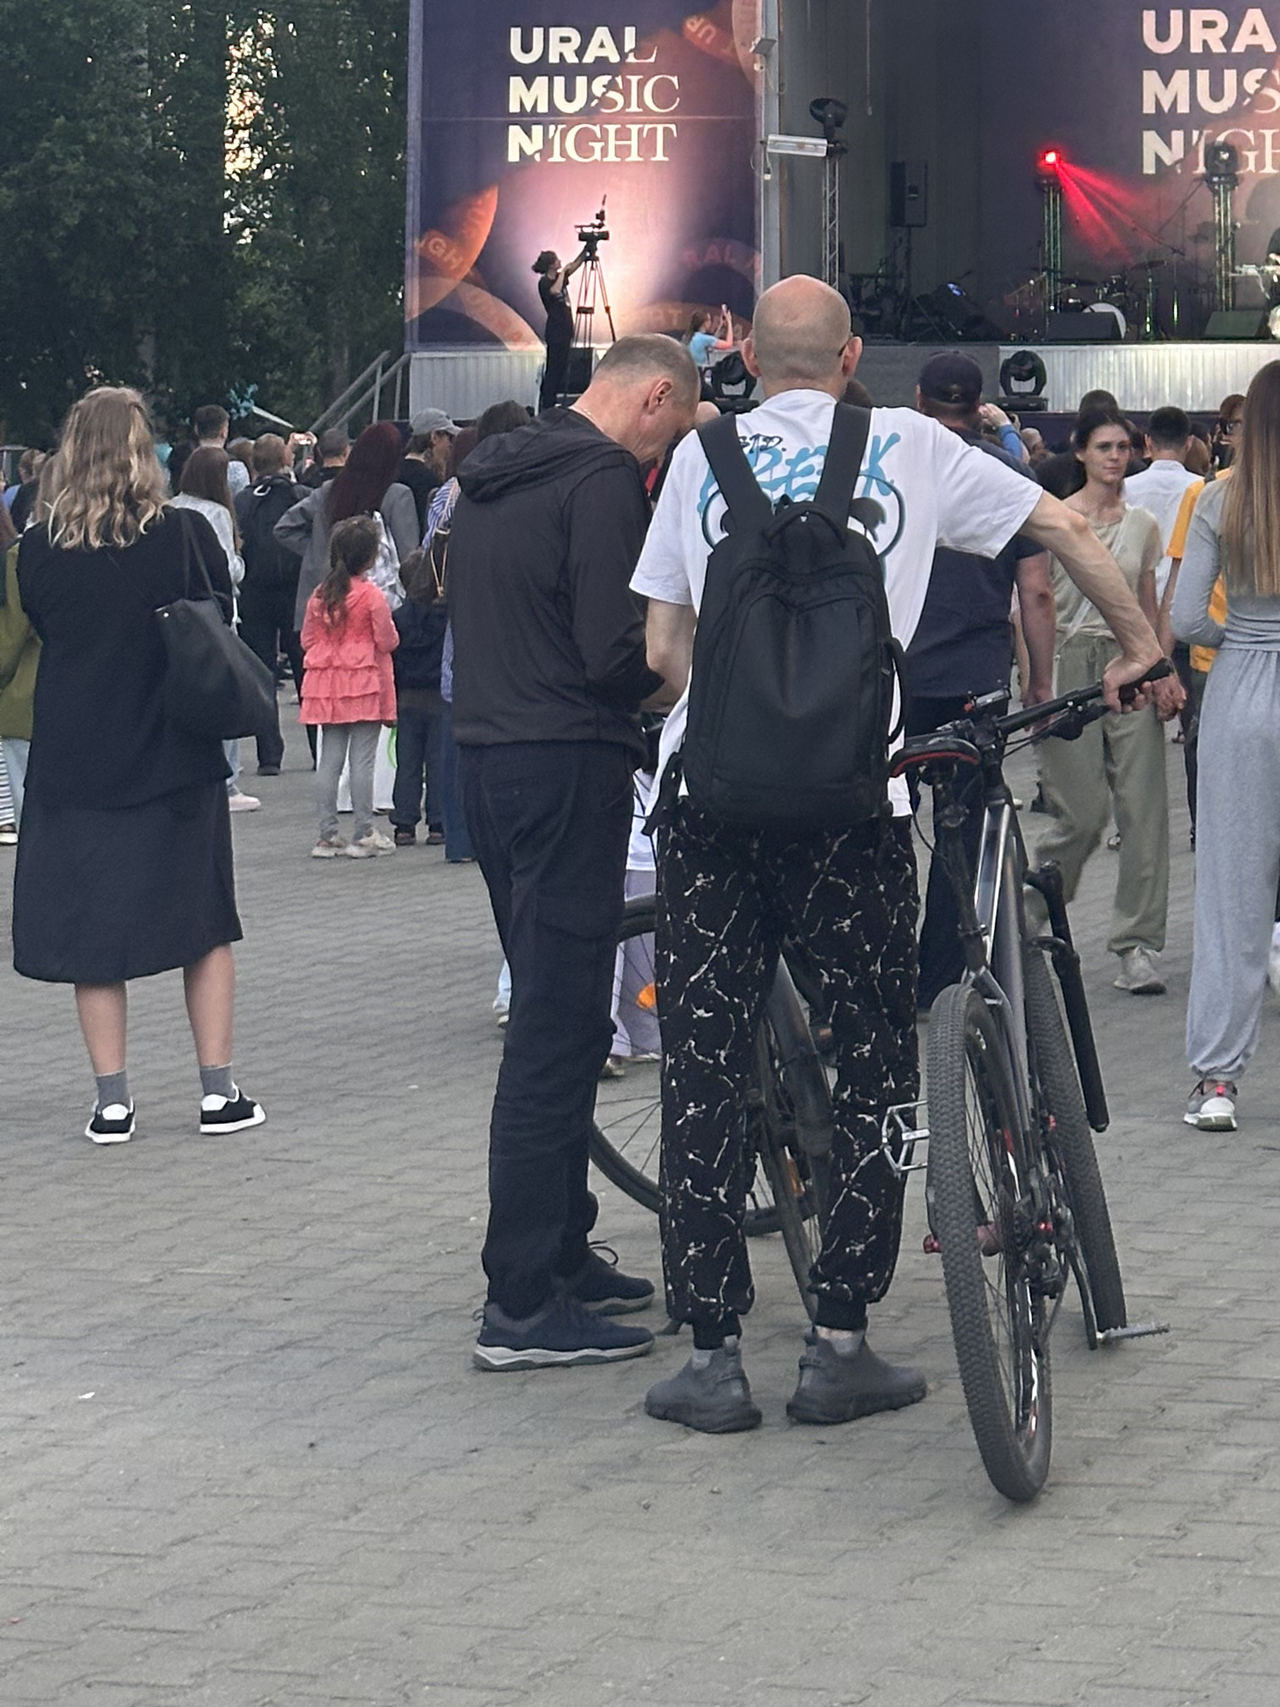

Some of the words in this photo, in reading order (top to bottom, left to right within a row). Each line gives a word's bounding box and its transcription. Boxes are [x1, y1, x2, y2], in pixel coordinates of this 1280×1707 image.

[510, 26, 658, 64] URAL
[509, 74, 680, 113] MUSIC
[508, 124, 678, 162] NIGHT
